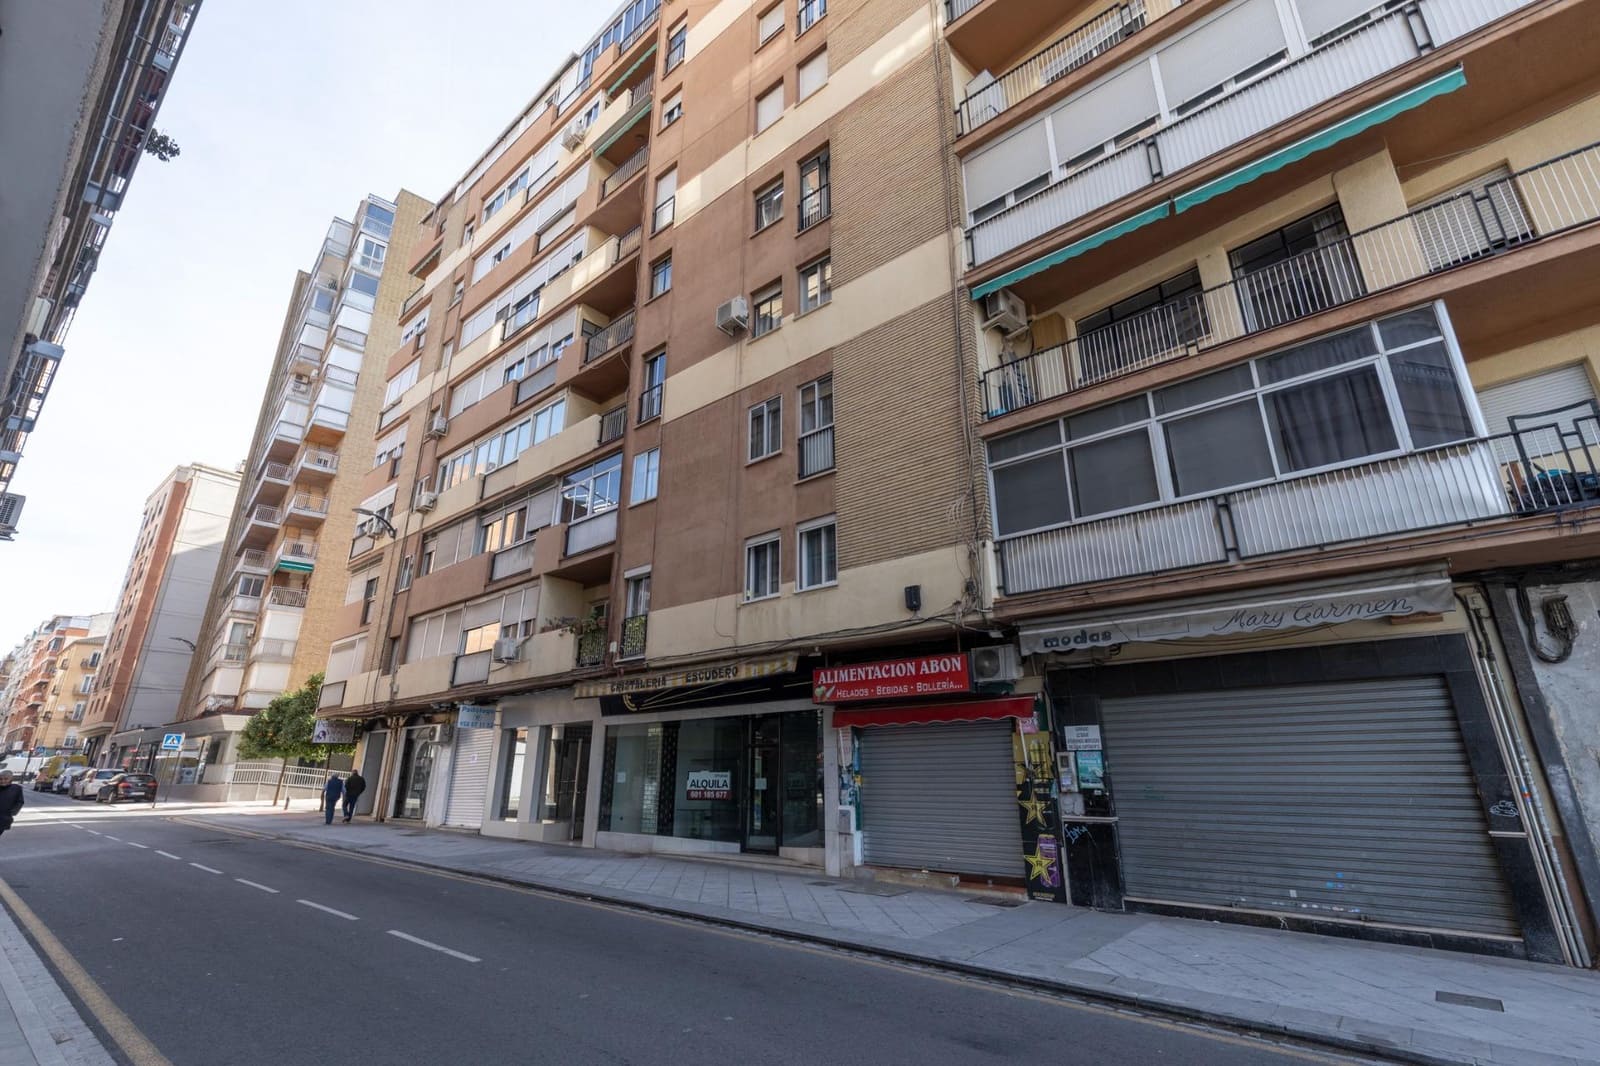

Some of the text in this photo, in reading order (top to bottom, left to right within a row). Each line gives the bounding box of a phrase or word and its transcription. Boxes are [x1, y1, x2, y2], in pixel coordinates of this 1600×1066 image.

[1213, 607, 1285, 631] Mary
[1043, 630, 1113, 648] modas
[685, 666, 739, 683] ESCUDERO
[818, 657, 962, 684] ALIMENTACION ABON
[836, 688, 869, 698] HELADOS
[876, 685, 908, 695] BEBIDAS
[690, 779, 728, 789] ALQUILA
